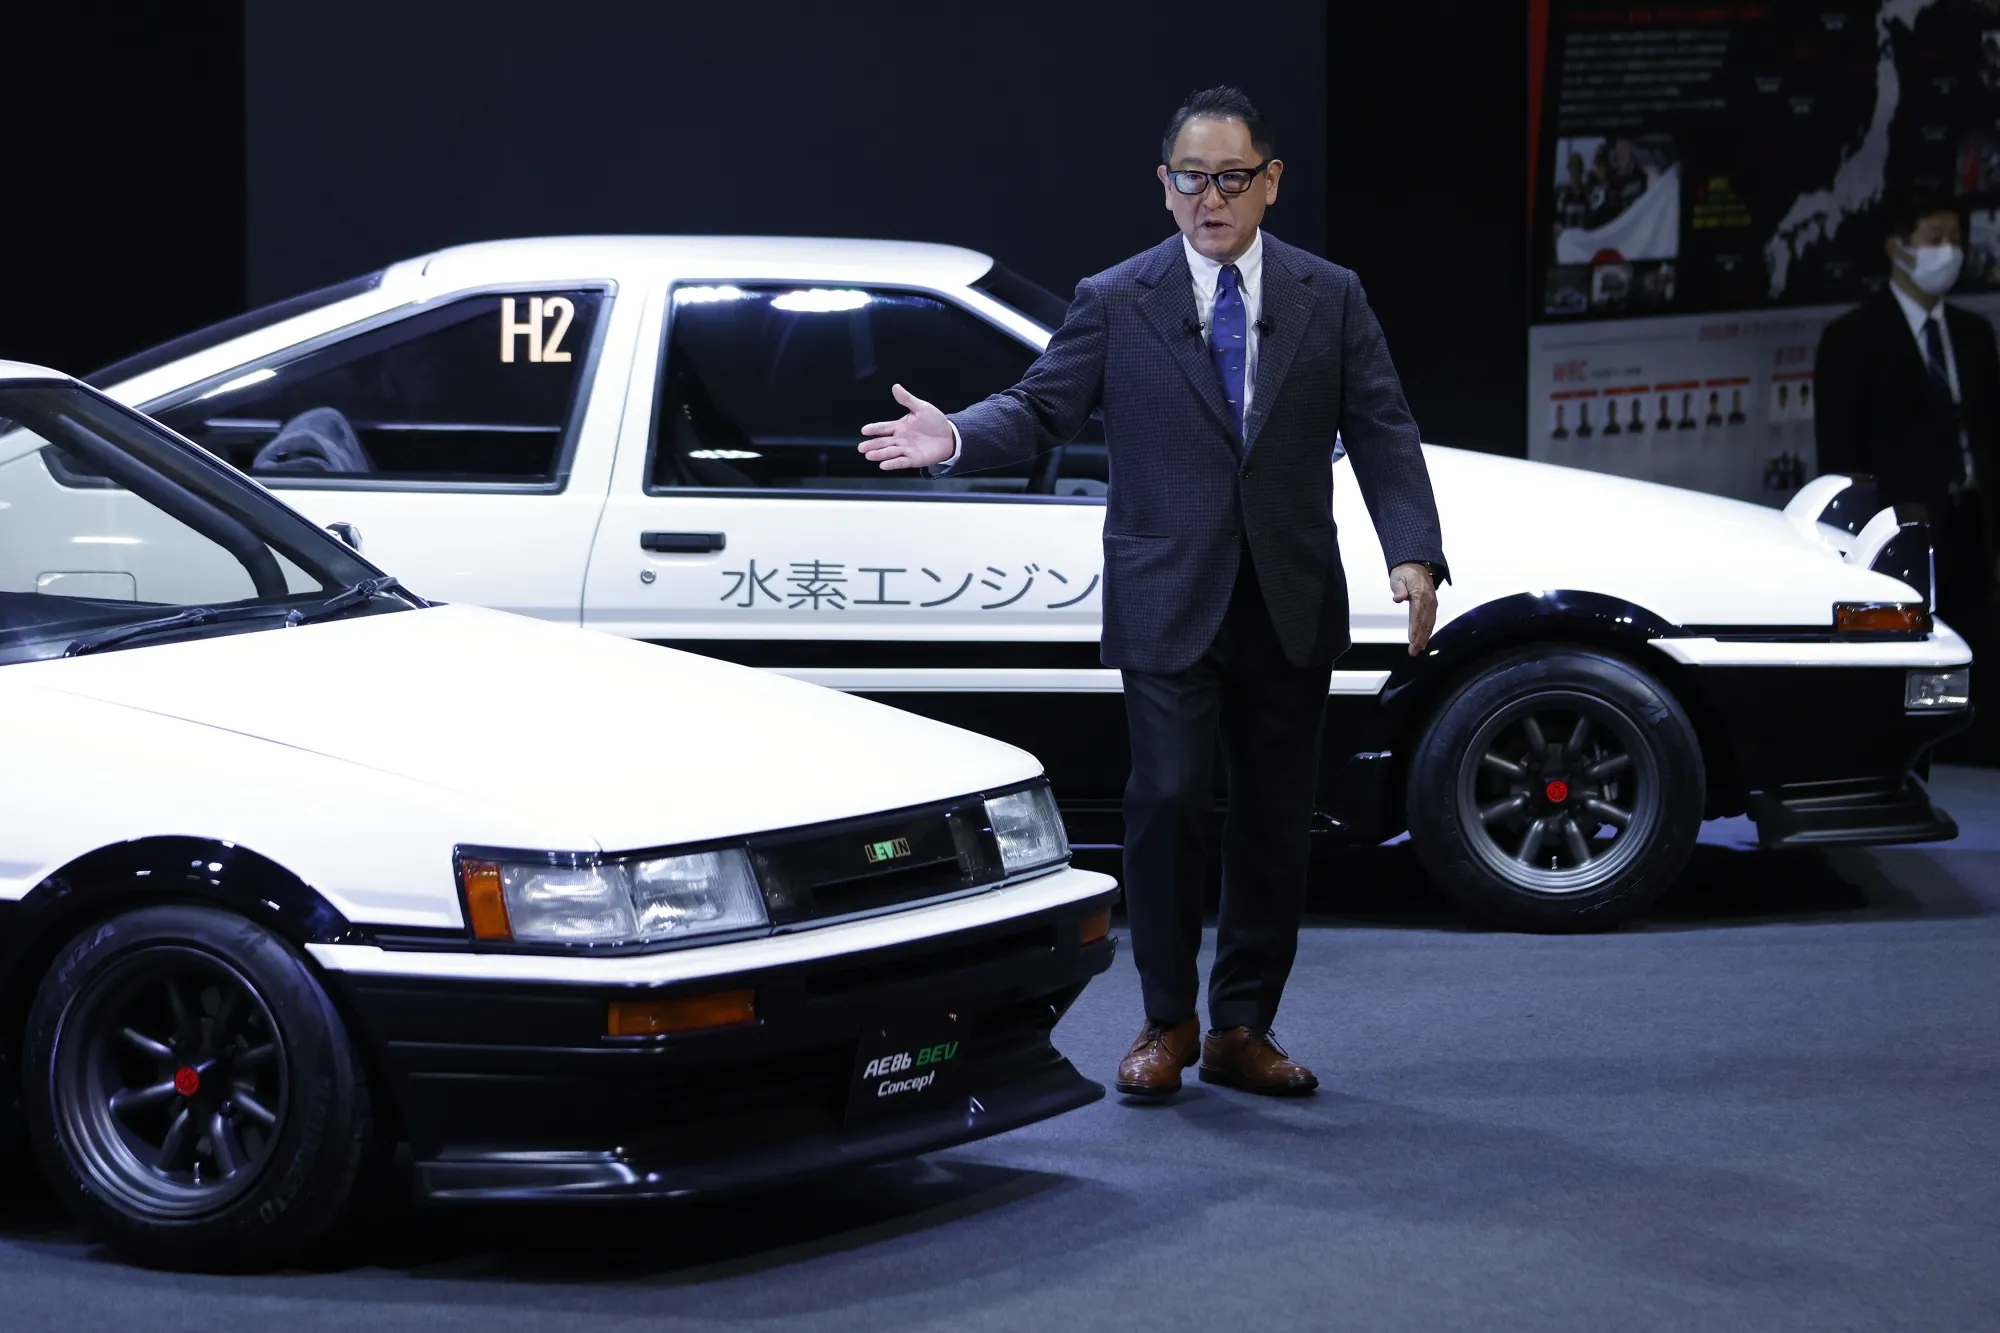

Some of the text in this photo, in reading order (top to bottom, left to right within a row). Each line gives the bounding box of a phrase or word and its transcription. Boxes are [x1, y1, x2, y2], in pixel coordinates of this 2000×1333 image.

[501, 297, 575, 363] H2
[720, 559, 1100, 610] 水素エンジン
[864, 837, 911, 863] LEVIN
[916, 1041, 959, 1067] BEV
[878, 1070, 935, 1097] Concept
